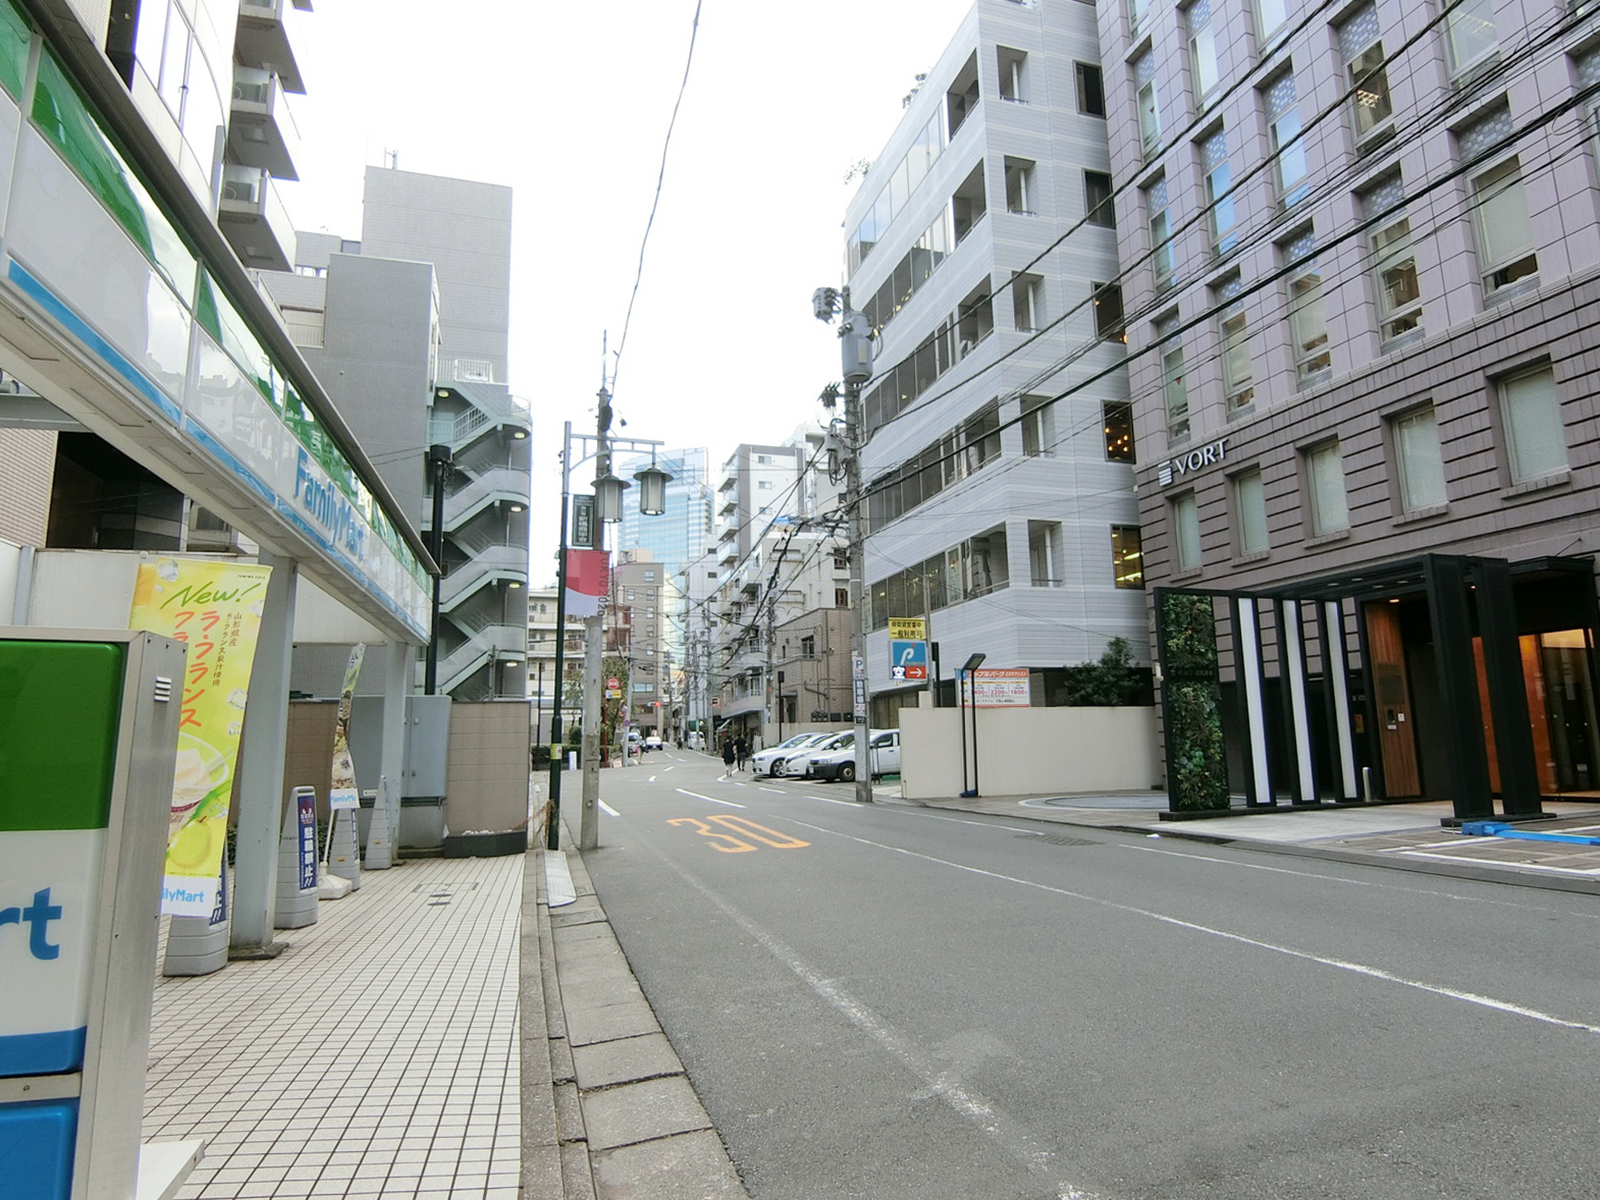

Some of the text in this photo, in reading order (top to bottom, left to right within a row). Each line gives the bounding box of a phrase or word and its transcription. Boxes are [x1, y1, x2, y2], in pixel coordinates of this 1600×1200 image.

[1175, 439, 1228, 475] VORT
[294, 446, 365, 561] FamilyMart
[160, 581, 261, 609] New!
[597, 589, 611, 617] 2020
[173, 611, 195, 642] フラ
[229, 612, 242, 646] 山形県産
[179, 611, 220, 728] ラ・フランス
[856, 660, 863, 669] P
[892, 666, 906, 679] 空
[666, 814, 811, 853] 30
[161, 888, 205, 903] ilyMart
